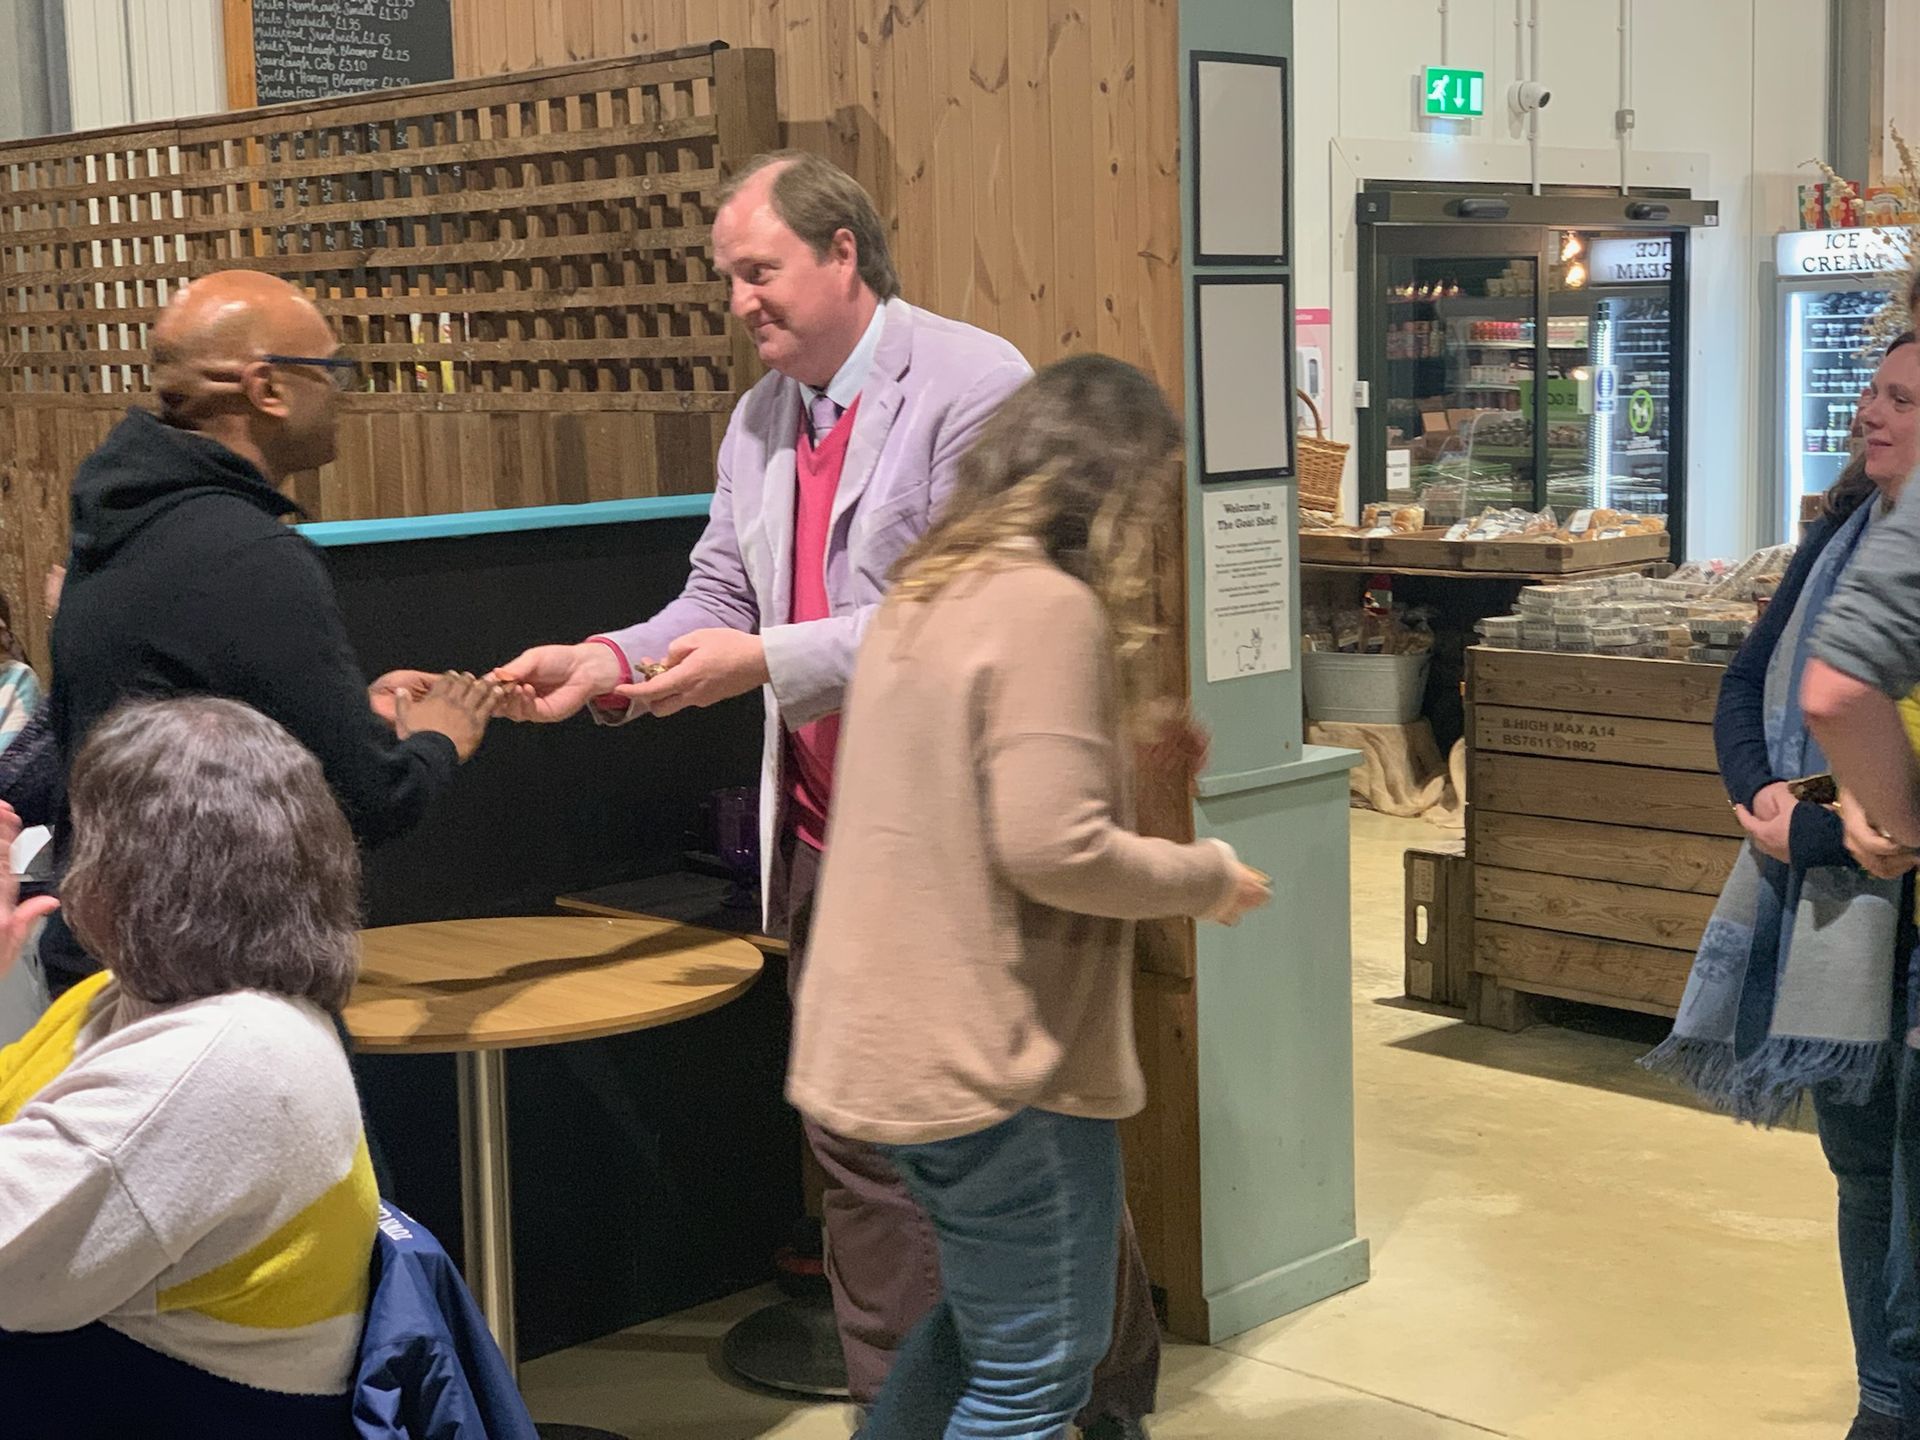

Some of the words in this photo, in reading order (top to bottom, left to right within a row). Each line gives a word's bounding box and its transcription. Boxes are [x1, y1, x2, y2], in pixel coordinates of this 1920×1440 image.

[284, 12, 333, 29] Sandwich
[308, 27, 362, 45] Sandwich
[285, 40, 340, 63] Sourdough
[256, 53, 313, 75] Sourdough
[314, 57, 336, 71] Cob
[1825, 232, 1860, 250] ICE
[1802, 254, 1884, 273] CREAM
[1224, 504, 1261, 513] Welcome
[1217, 520, 1233, 530] The
[1514, 719, 1549, 732] HIGH
[1552, 722, 1585, 735] MAX
[1589, 725, 1616, 737] A14
